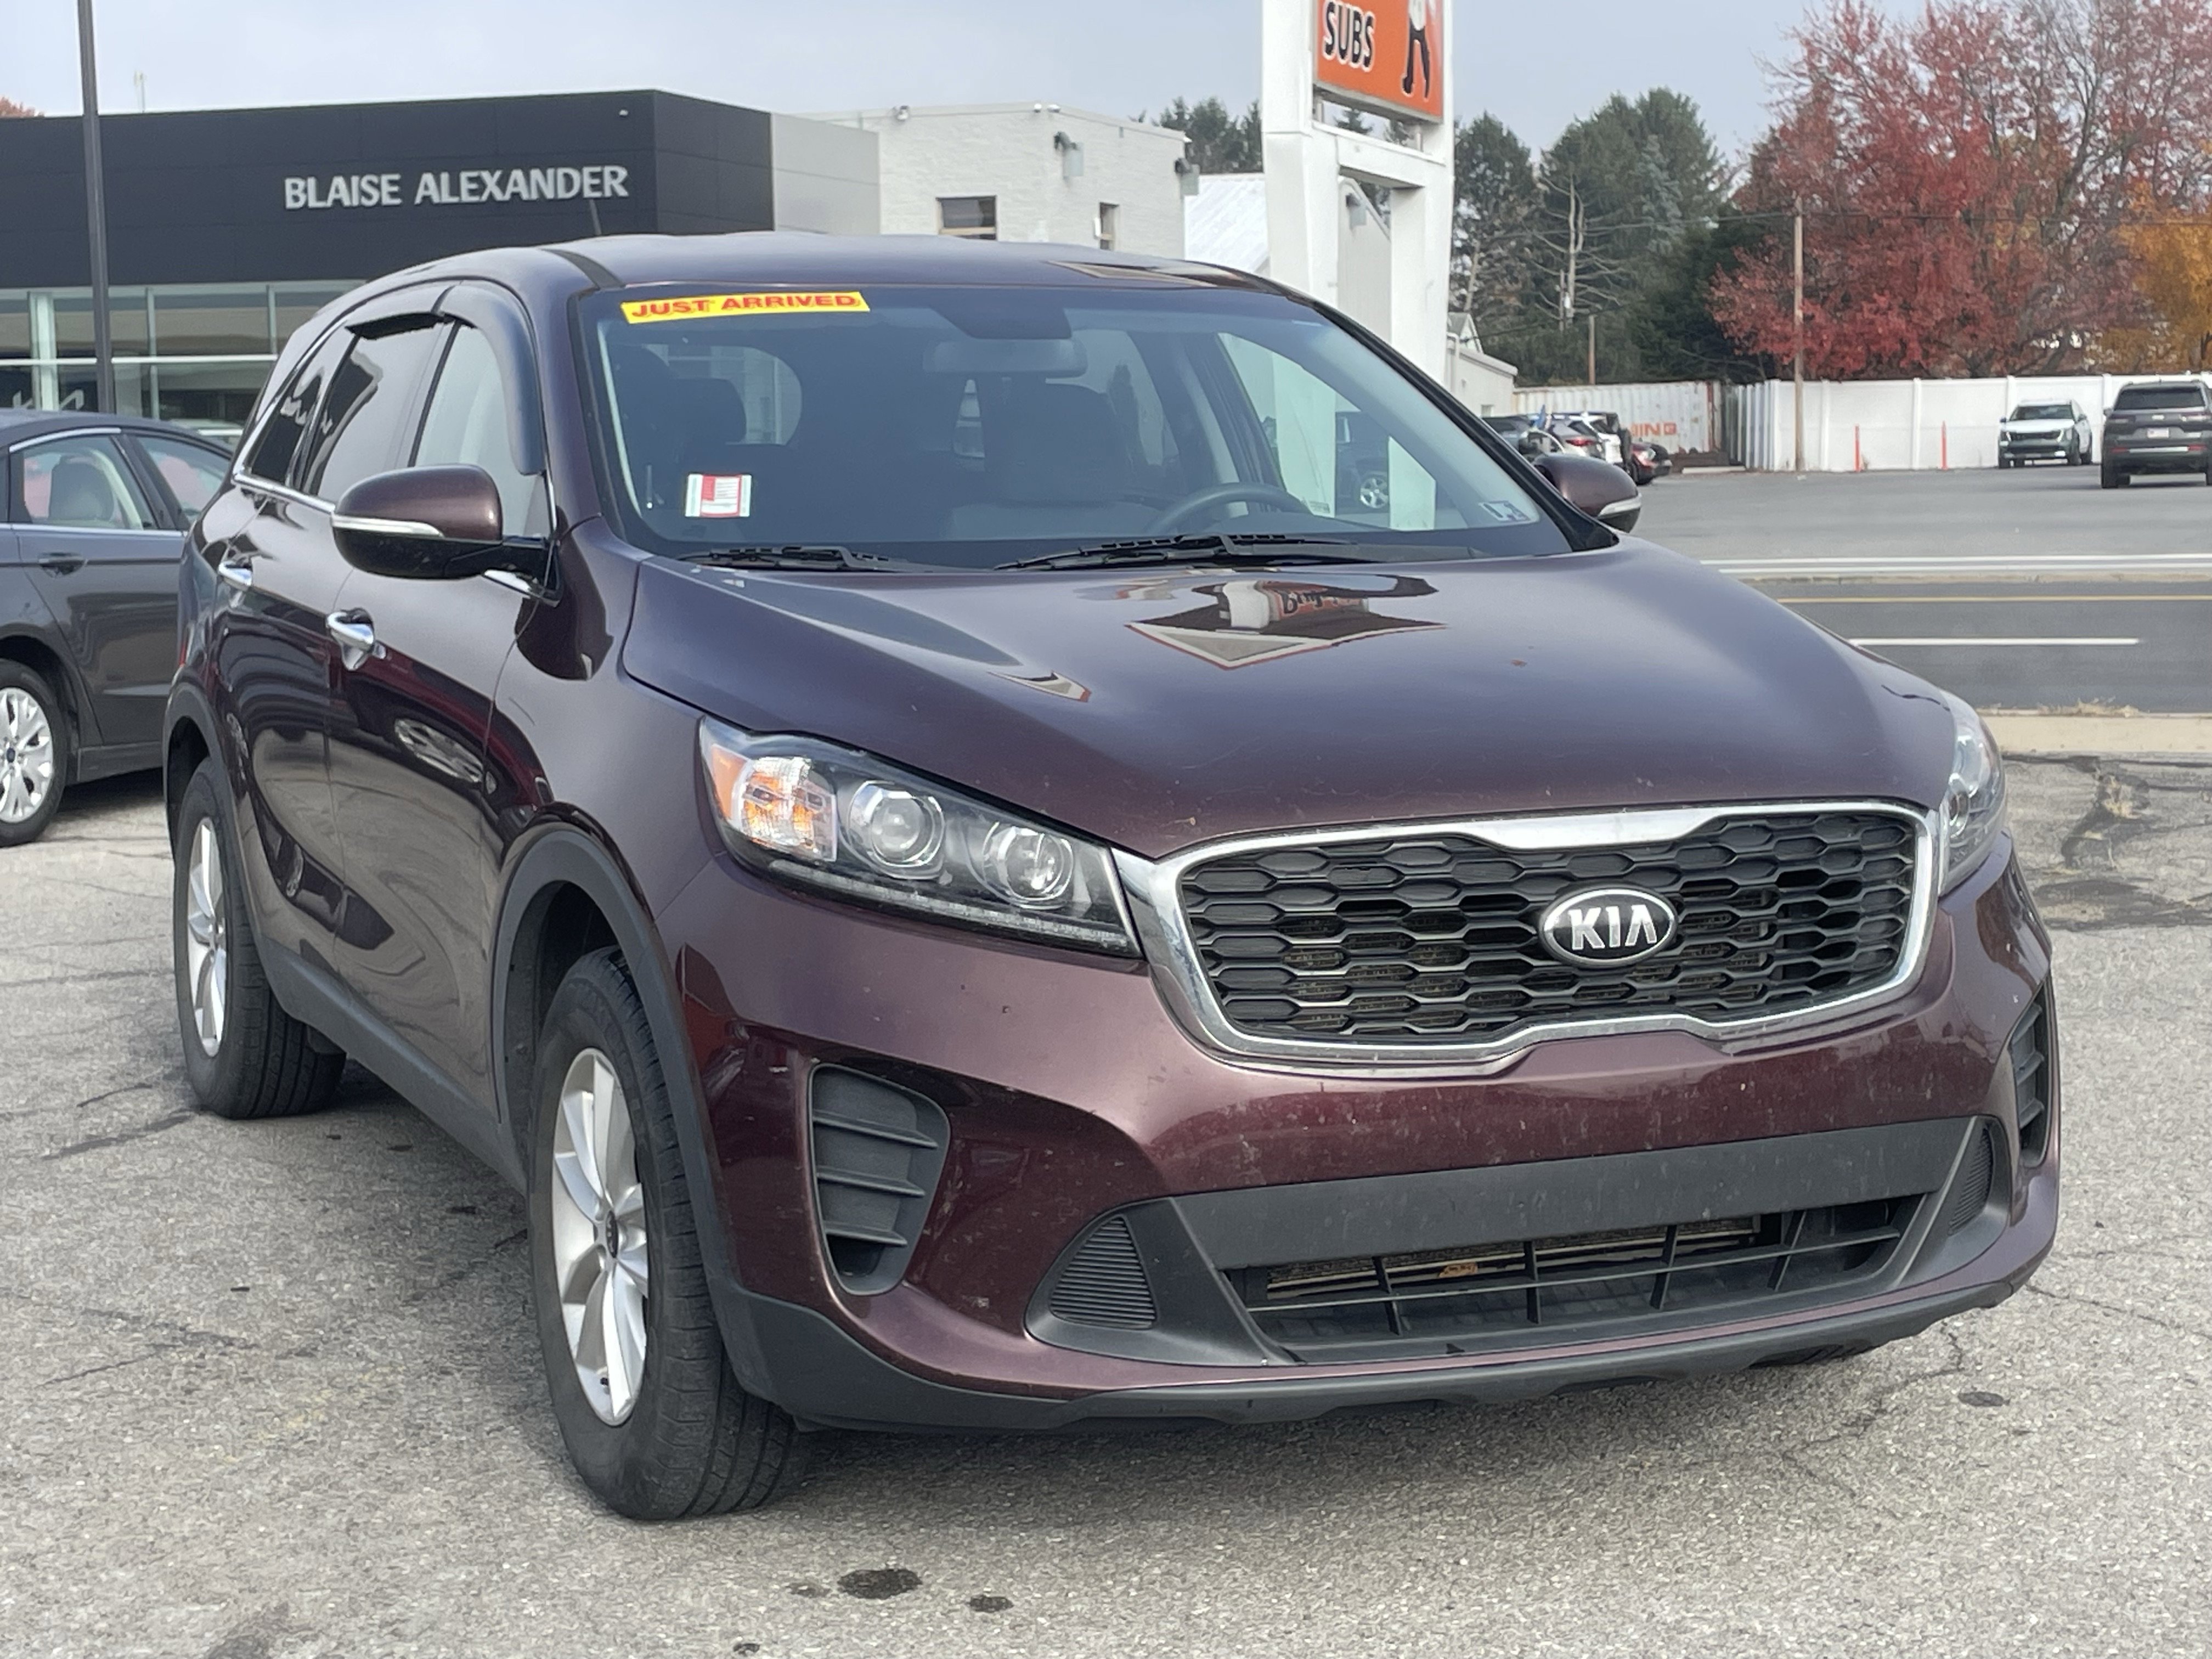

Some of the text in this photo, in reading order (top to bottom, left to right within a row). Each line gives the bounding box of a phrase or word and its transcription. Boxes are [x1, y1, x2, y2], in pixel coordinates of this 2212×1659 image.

[1323, 0, 1375, 71] SUBS
[284, 166, 629, 210] BLAISE ALEXANDER
[631, 295, 858, 318] JUST ARRIVED
[1567, 904, 1658, 951] KIA
